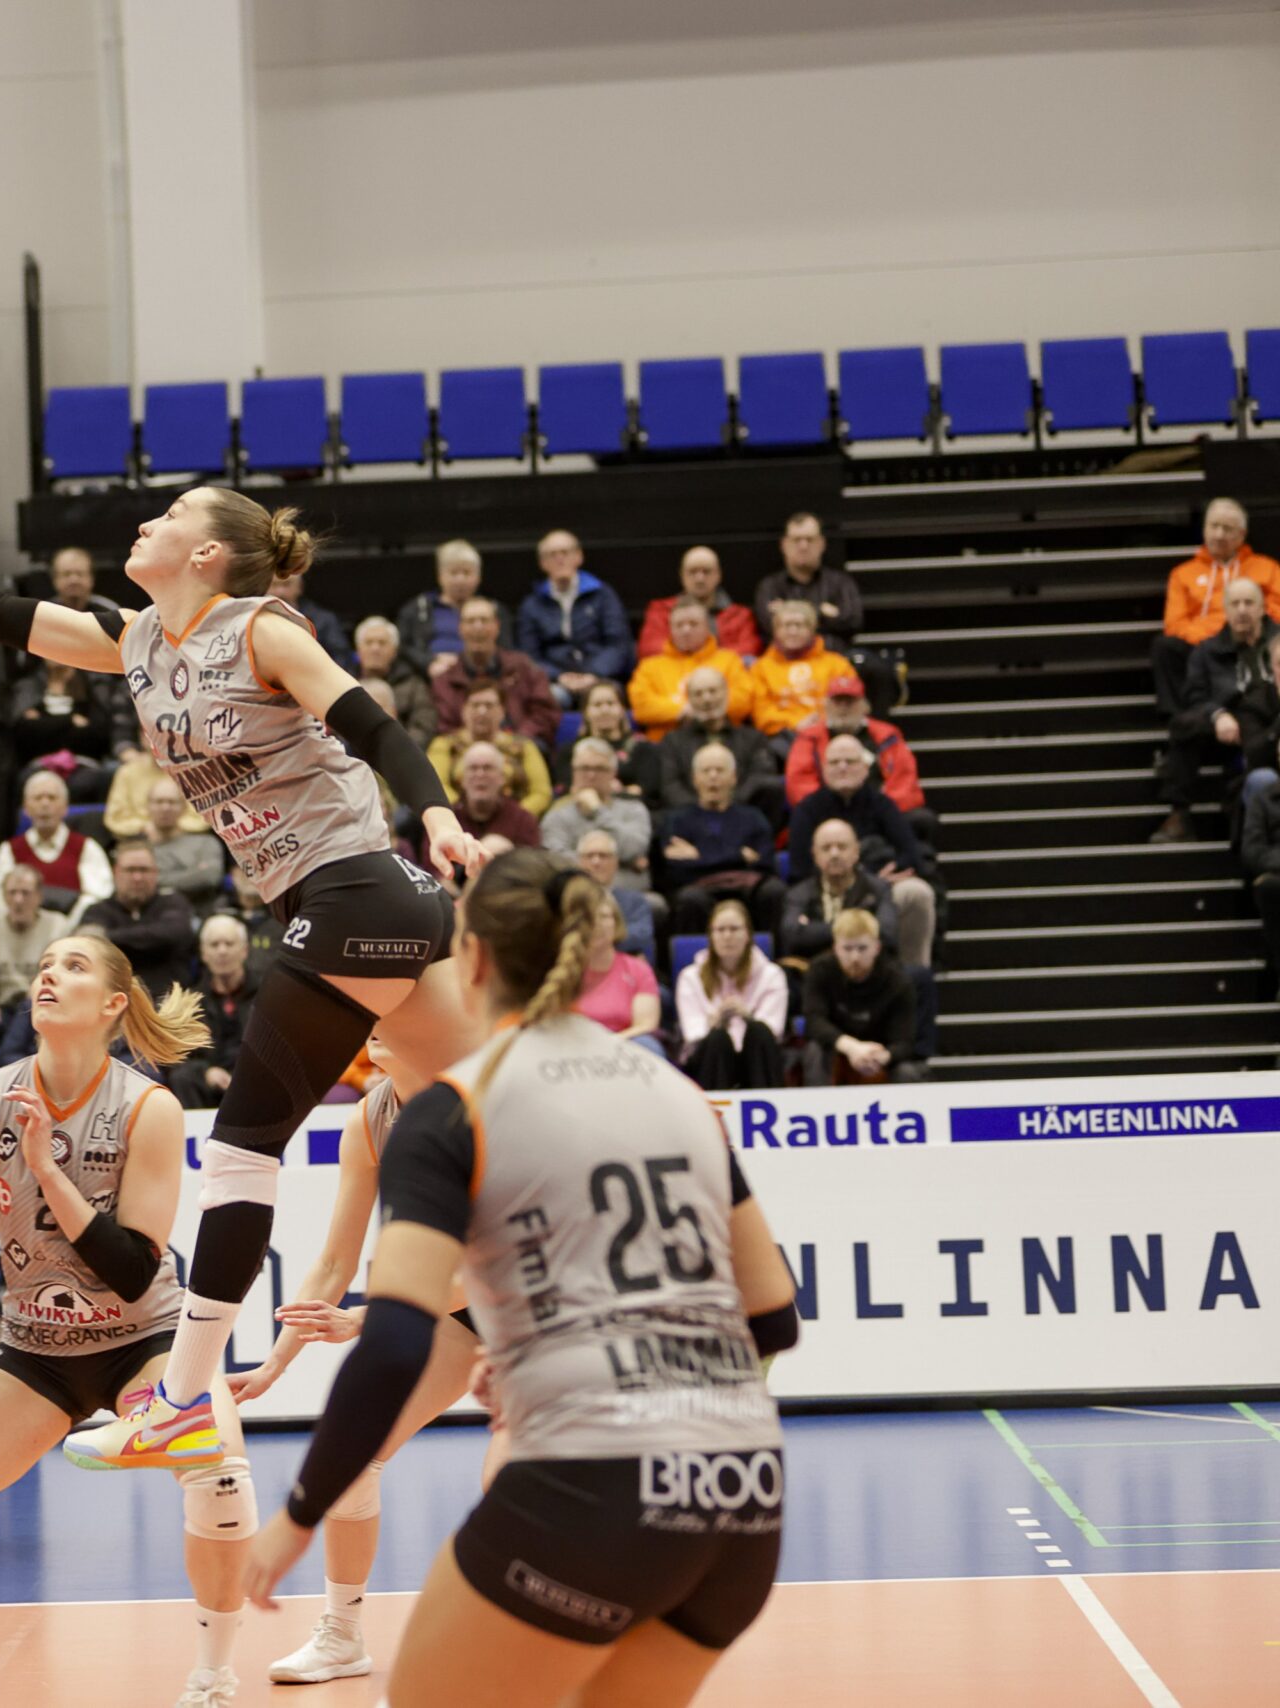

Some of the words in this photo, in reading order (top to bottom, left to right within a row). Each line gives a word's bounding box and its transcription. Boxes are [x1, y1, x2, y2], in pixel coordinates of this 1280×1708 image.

[282, 917, 312, 949] 22
[741, 1100, 927, 1149] Rauta
[1019, 1104, 1238, 1136] HÄMEENLINNA
[589, 1154, 714, 1295] 25
[777, 1231, 1261, 1321] NLINNA
